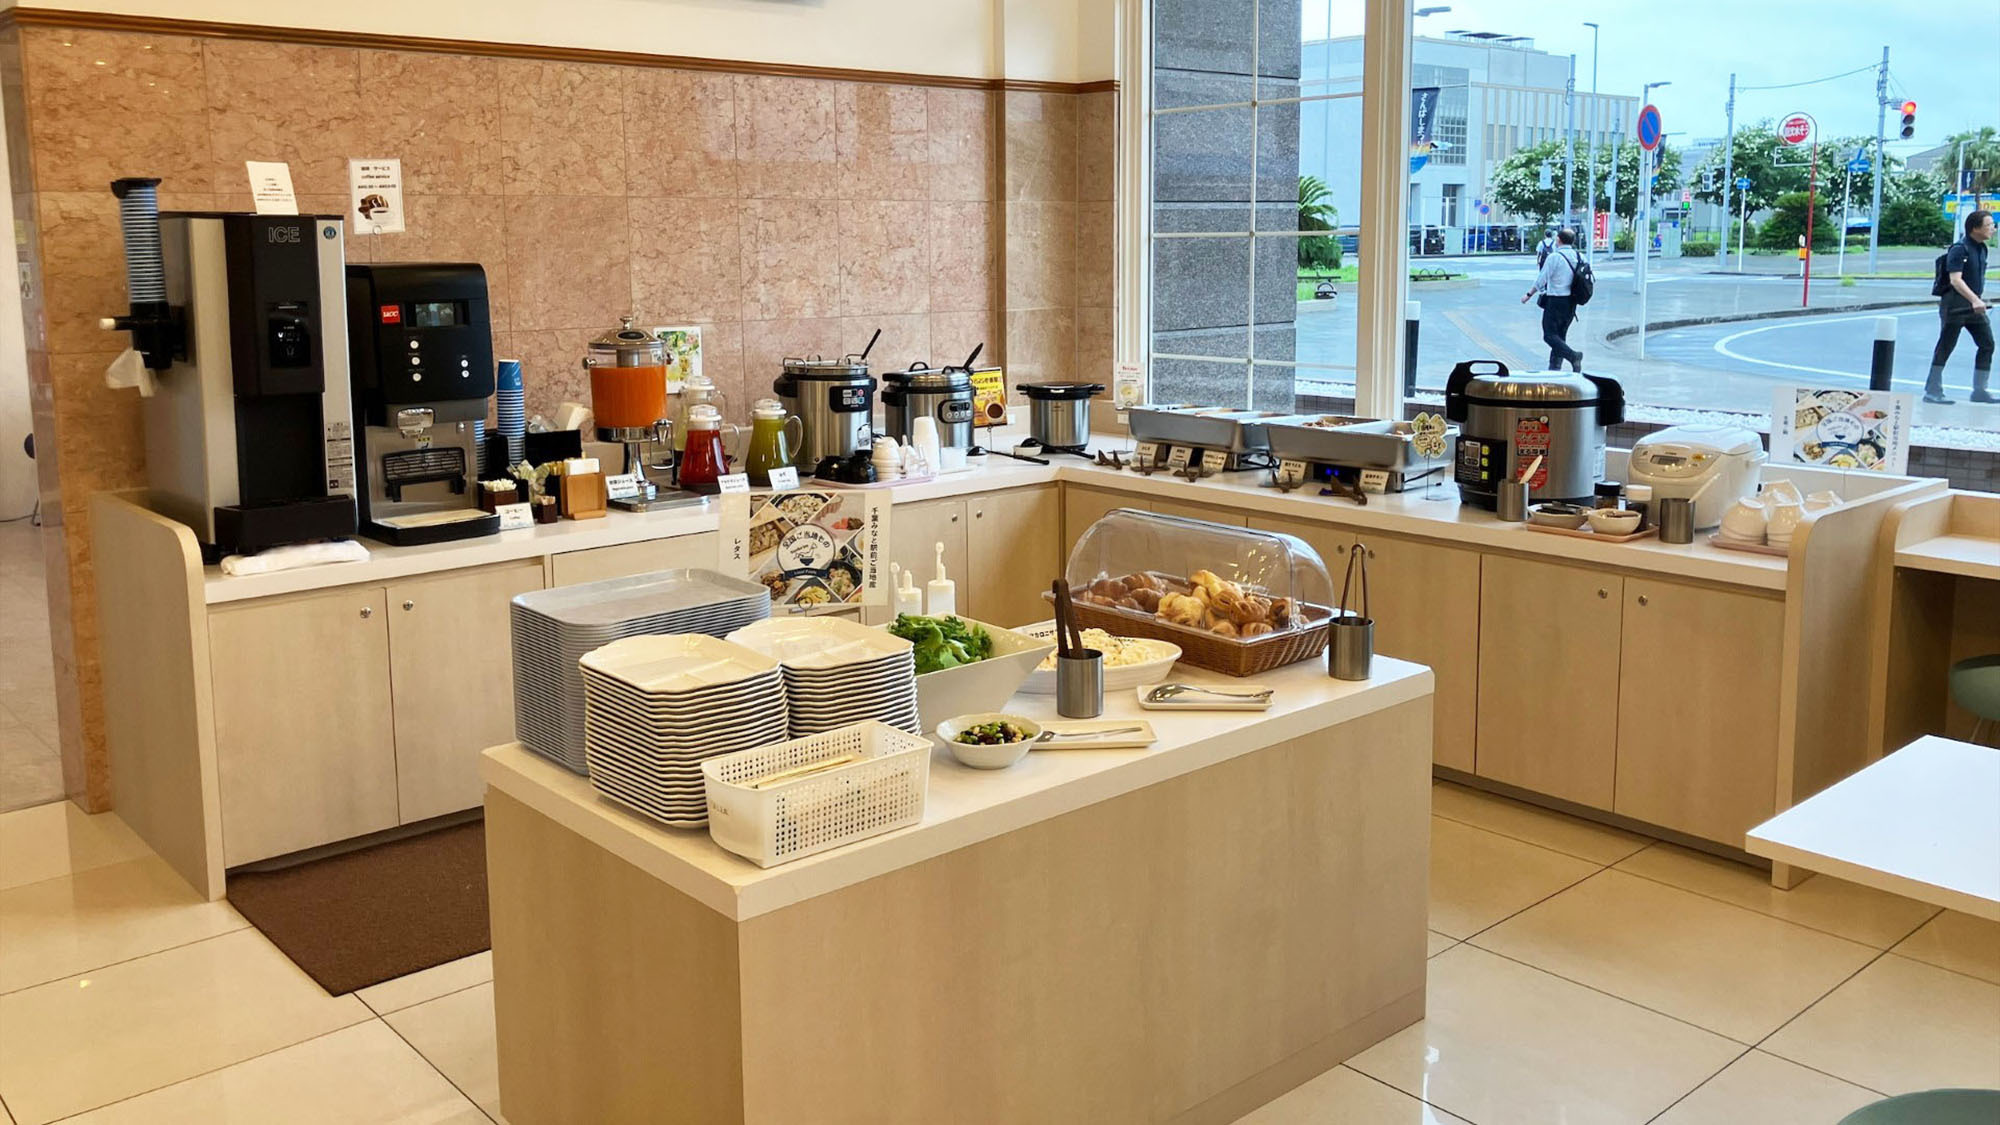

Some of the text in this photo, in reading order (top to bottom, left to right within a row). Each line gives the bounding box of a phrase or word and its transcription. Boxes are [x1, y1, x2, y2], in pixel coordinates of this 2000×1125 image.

[268, 226, 300, 243] ICE
[734, 537, 742, 560] レタス
